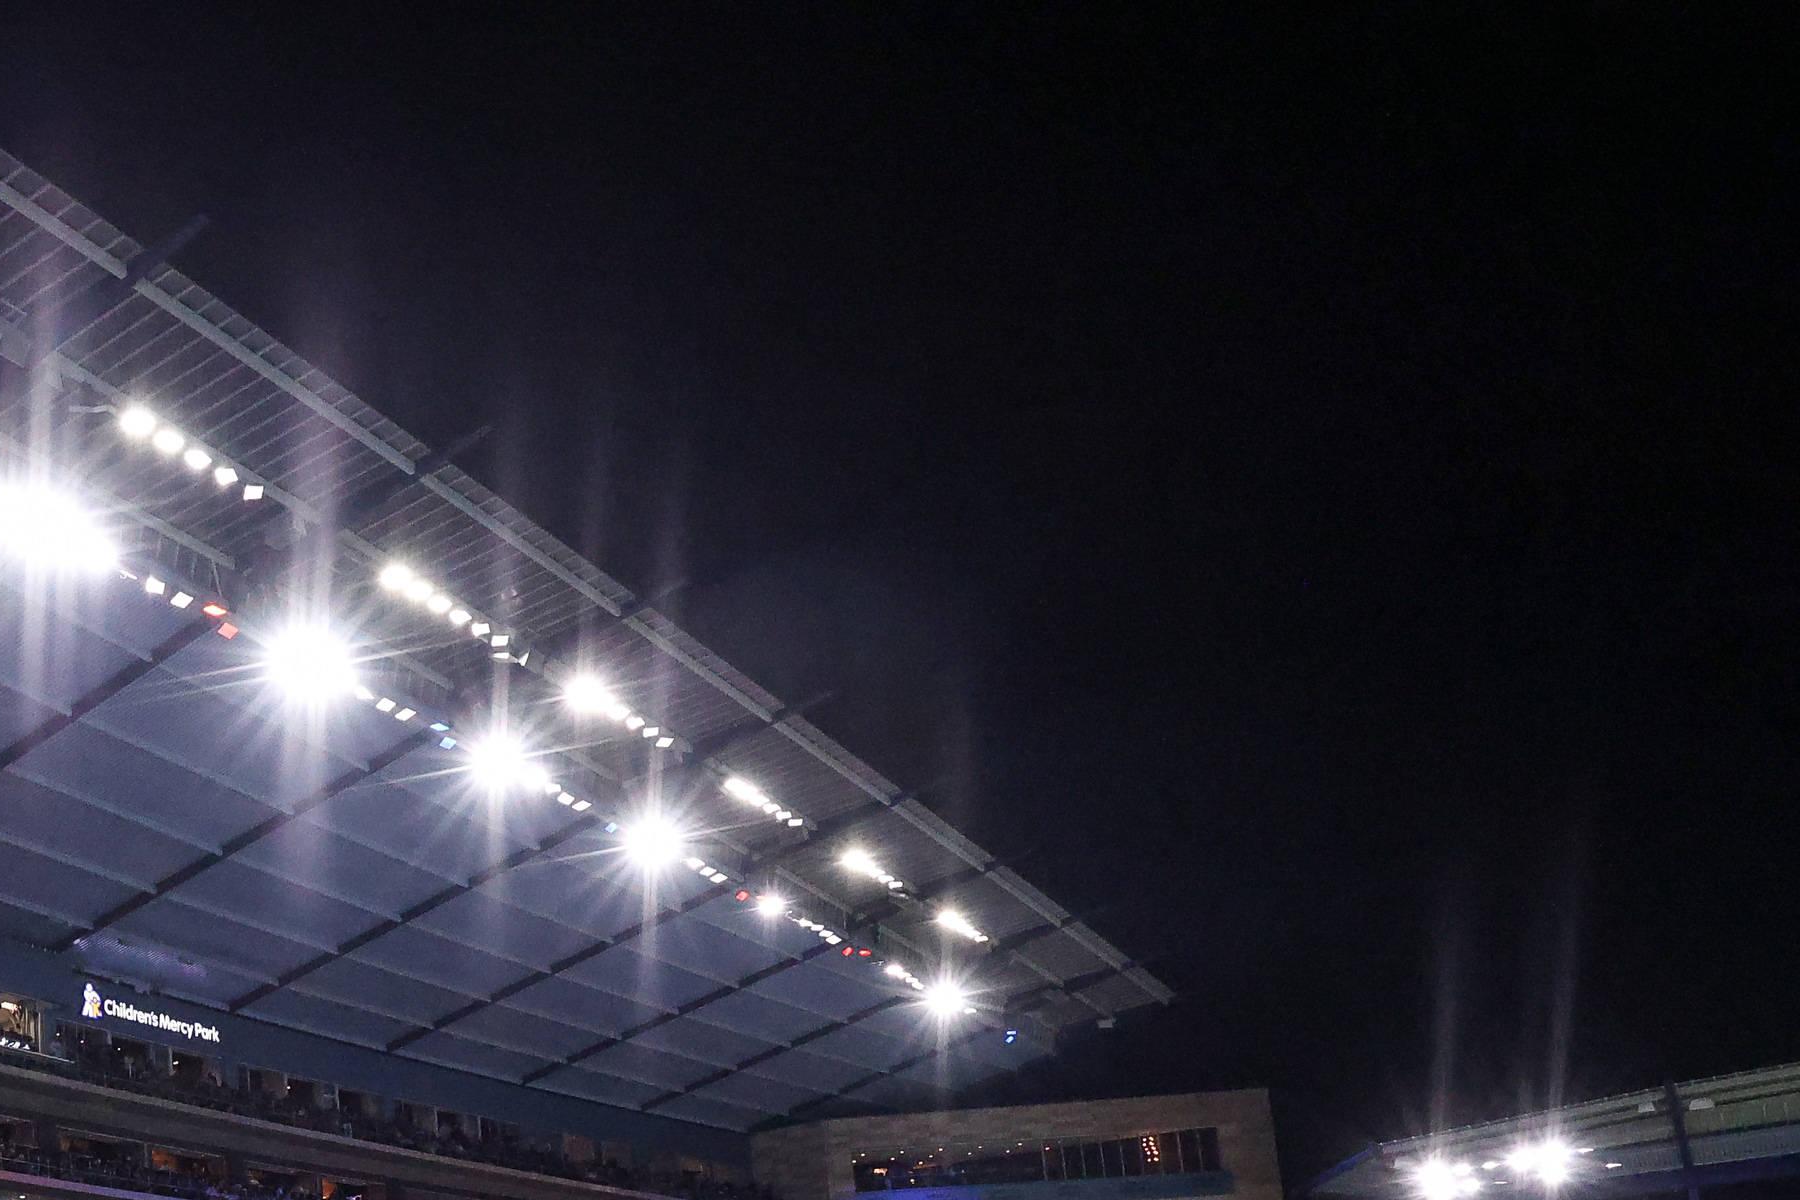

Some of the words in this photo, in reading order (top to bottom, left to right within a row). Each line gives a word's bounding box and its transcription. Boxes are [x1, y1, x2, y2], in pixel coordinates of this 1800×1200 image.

[104, 999, 159, 1027] Children's
[159, 1013, 194, 1039] Mercy
[194, 1022, 220, 1043] Park
